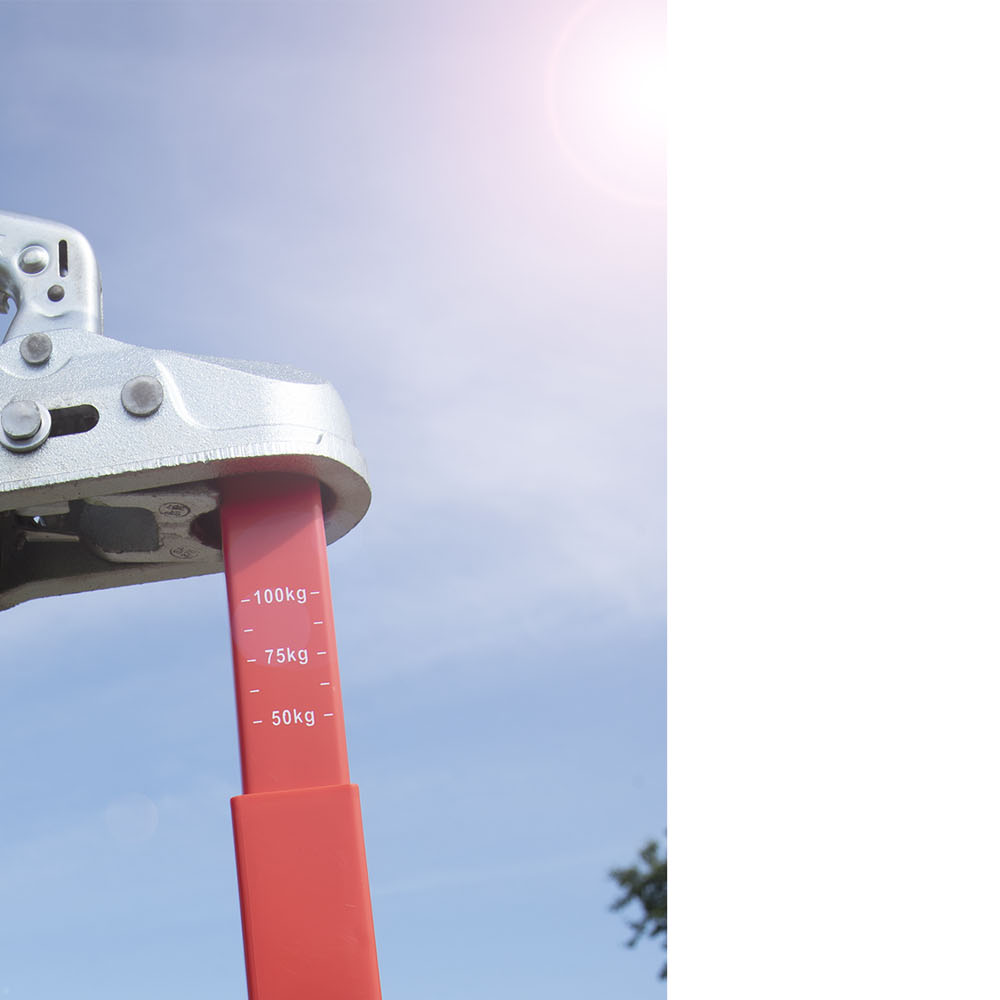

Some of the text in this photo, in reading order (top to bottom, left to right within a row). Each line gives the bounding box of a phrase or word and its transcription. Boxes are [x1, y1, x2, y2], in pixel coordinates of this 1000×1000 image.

[254, 587, 307, 605] 100kg
[265, 648, 309, 665] 75kg
[271, 709, 315, 727] 50kg
